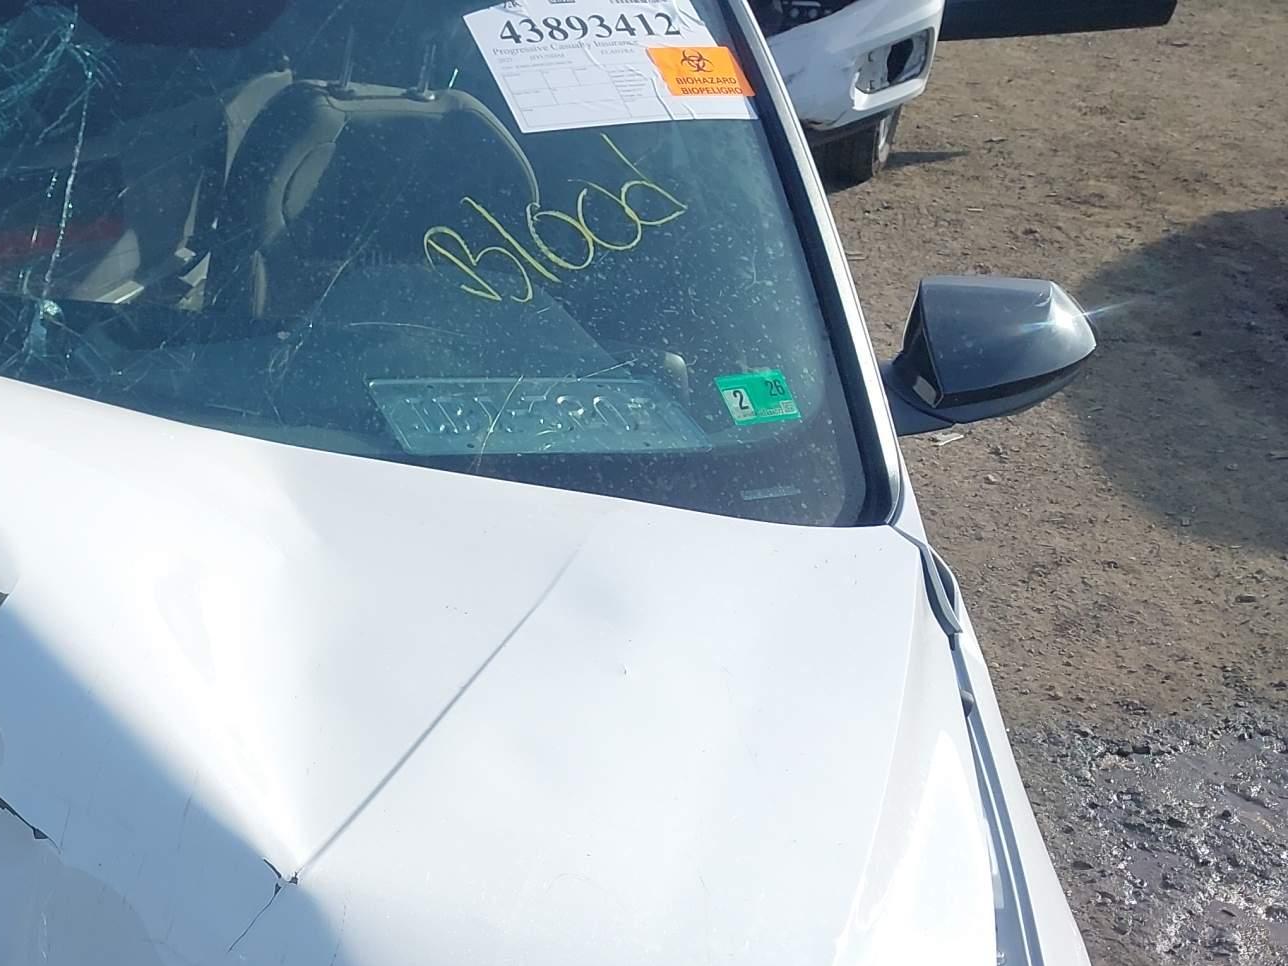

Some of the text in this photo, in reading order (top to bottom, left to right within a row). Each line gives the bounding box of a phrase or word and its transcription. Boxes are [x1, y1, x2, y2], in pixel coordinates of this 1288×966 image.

[500, 12, 681, 44] 43893412
[492, 44, 550, 56] Progressive
[676, 77, 737, 85] BIOHAZARD
[680, 86, 743, 95] BIOPELIGRO
[423, 132, 689, 303] Blood
[765, 378, 785, 397] 26
[732, 389, 749, 410] 2
